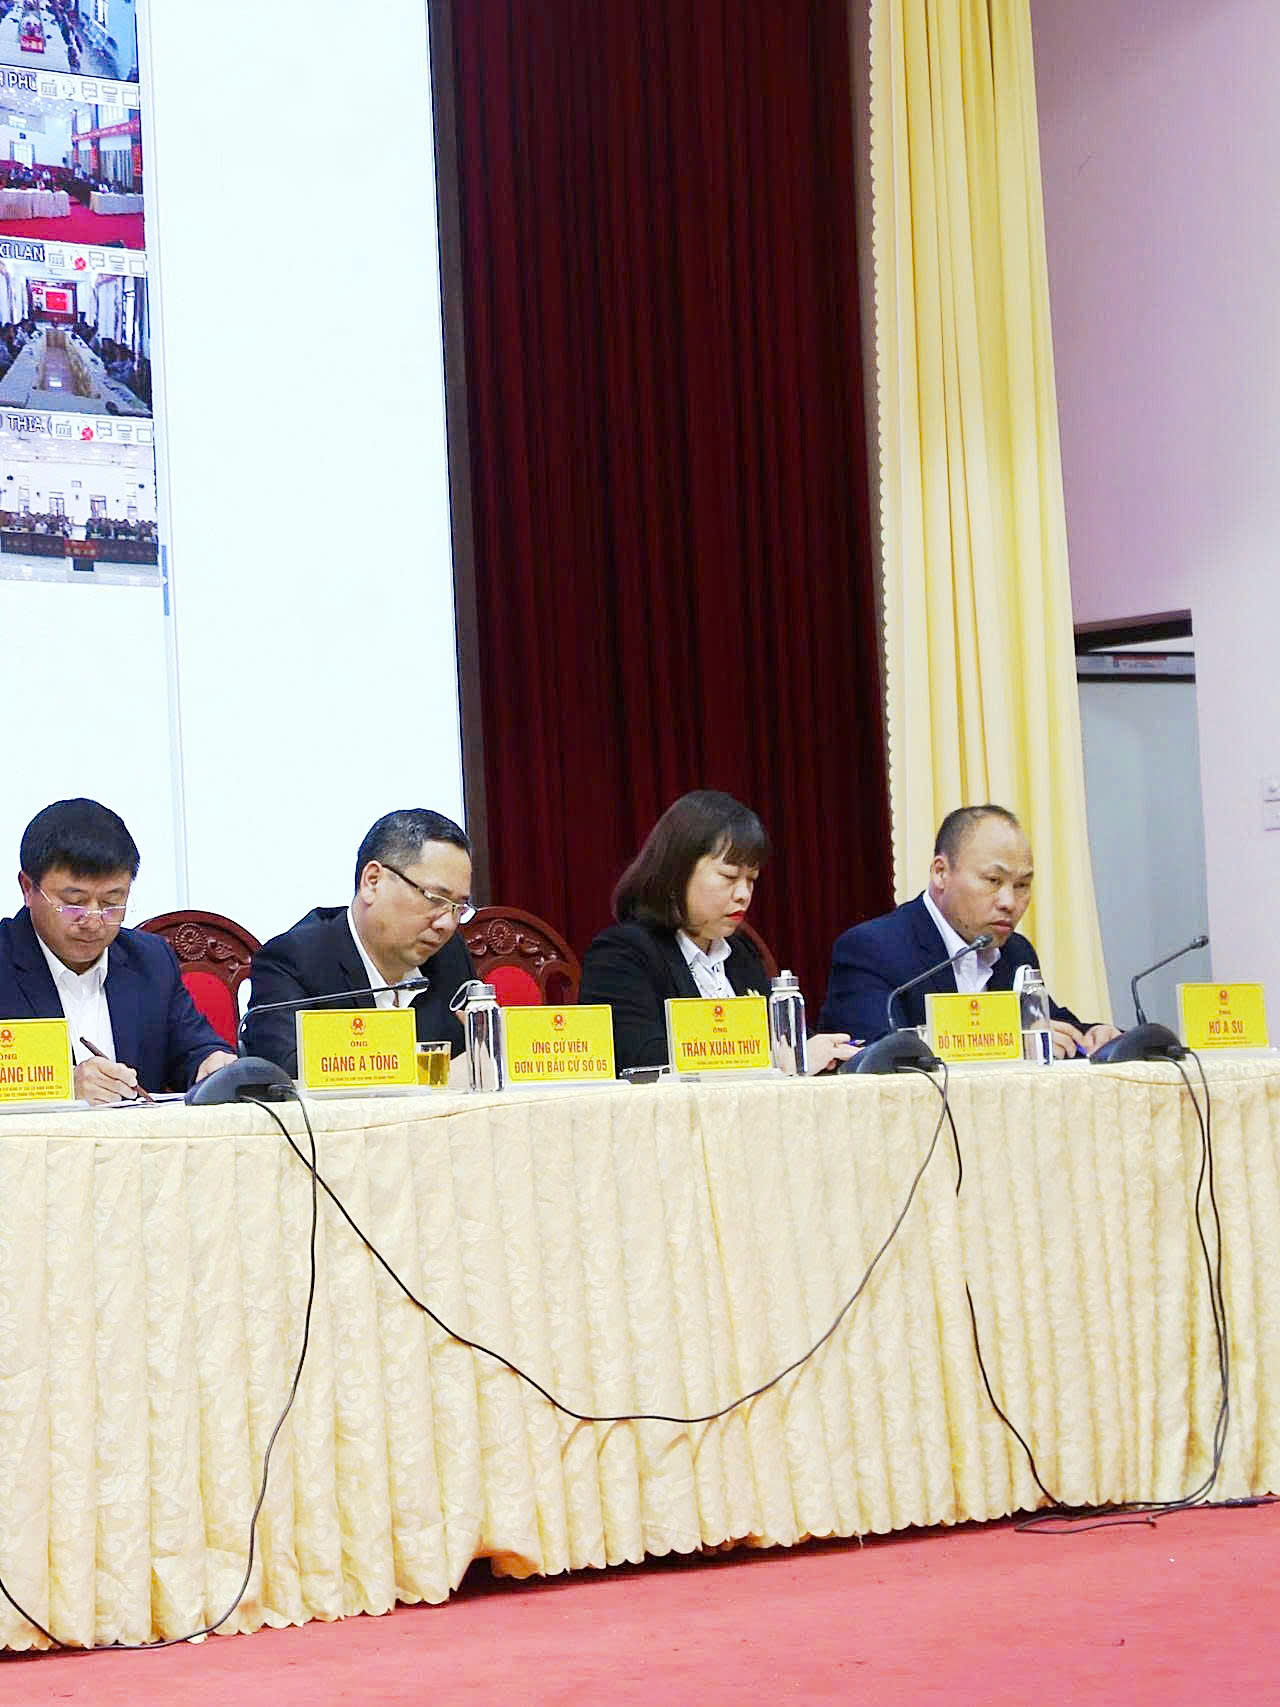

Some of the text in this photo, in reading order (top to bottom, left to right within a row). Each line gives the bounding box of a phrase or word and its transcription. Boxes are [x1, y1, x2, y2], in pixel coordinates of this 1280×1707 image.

[968, 1033, 995, 1048] THANH
[359, 1055, 366, 1071] A
[596, 1059, 608, 1071] 05
[27, 1065, 54, 1082] LINH
